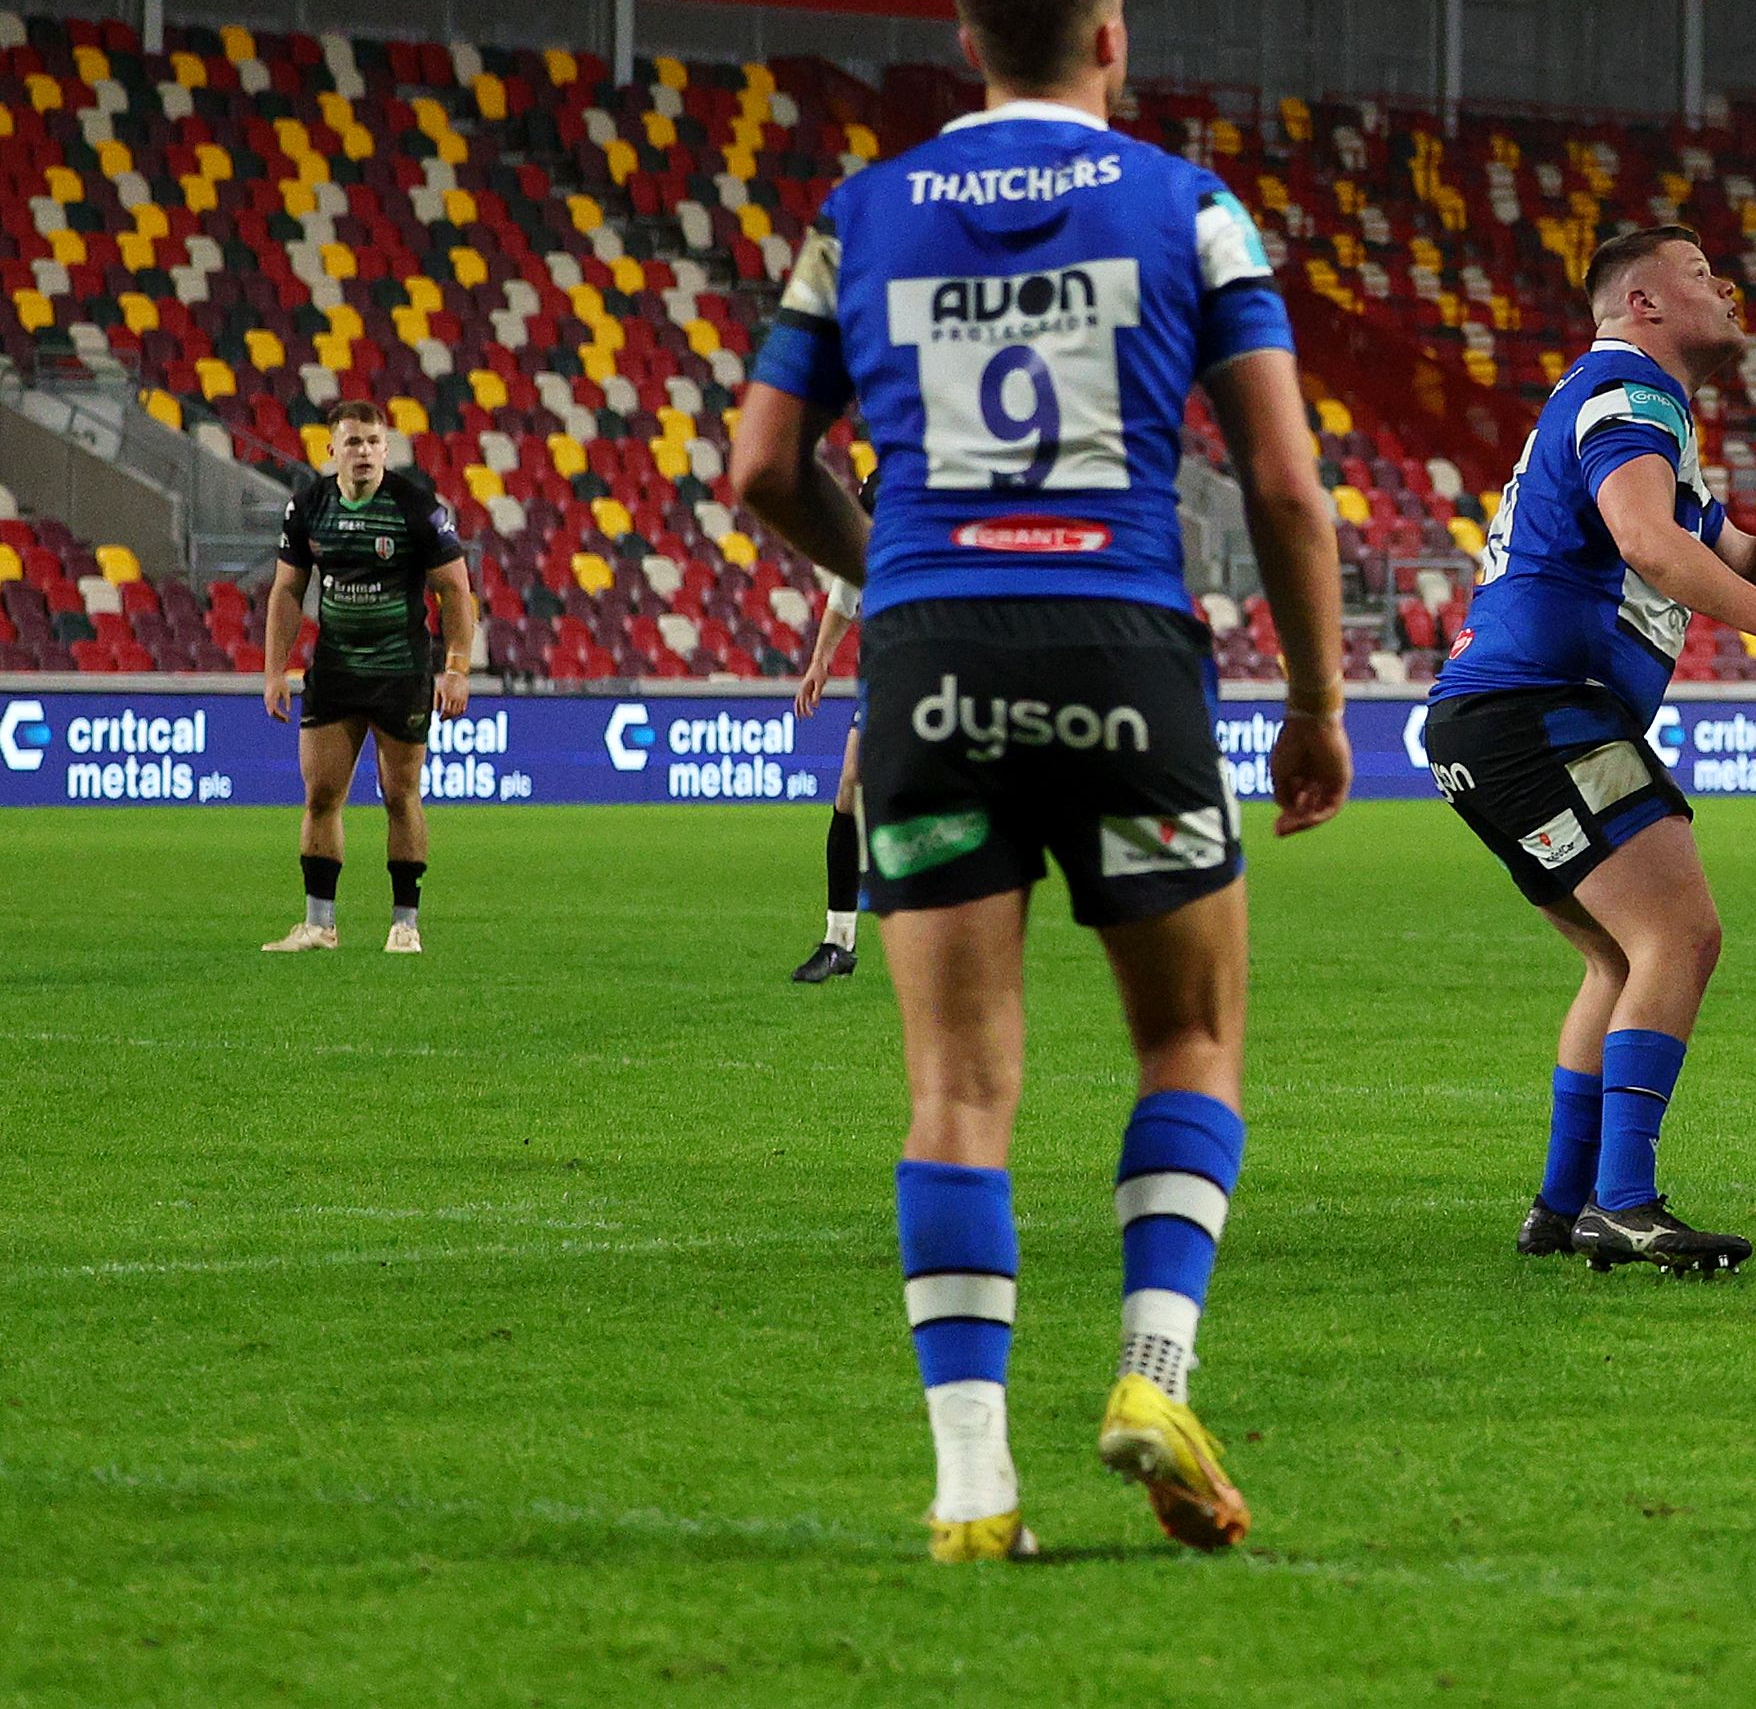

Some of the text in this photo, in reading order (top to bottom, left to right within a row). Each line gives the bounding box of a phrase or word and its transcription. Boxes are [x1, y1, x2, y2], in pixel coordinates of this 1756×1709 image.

[906, 154, 1103, 205] THATCHERS
[980, 345, 1061, 491] 9
[67, 709, 206, 753] critical
[668, 711, 795, 755] critical
[912, 674, 1149, 762] dyson
[67, 754, 233, 803] metals plc
[499, 770, 532, 801] plc
[668, 754, 783, 798] metals
